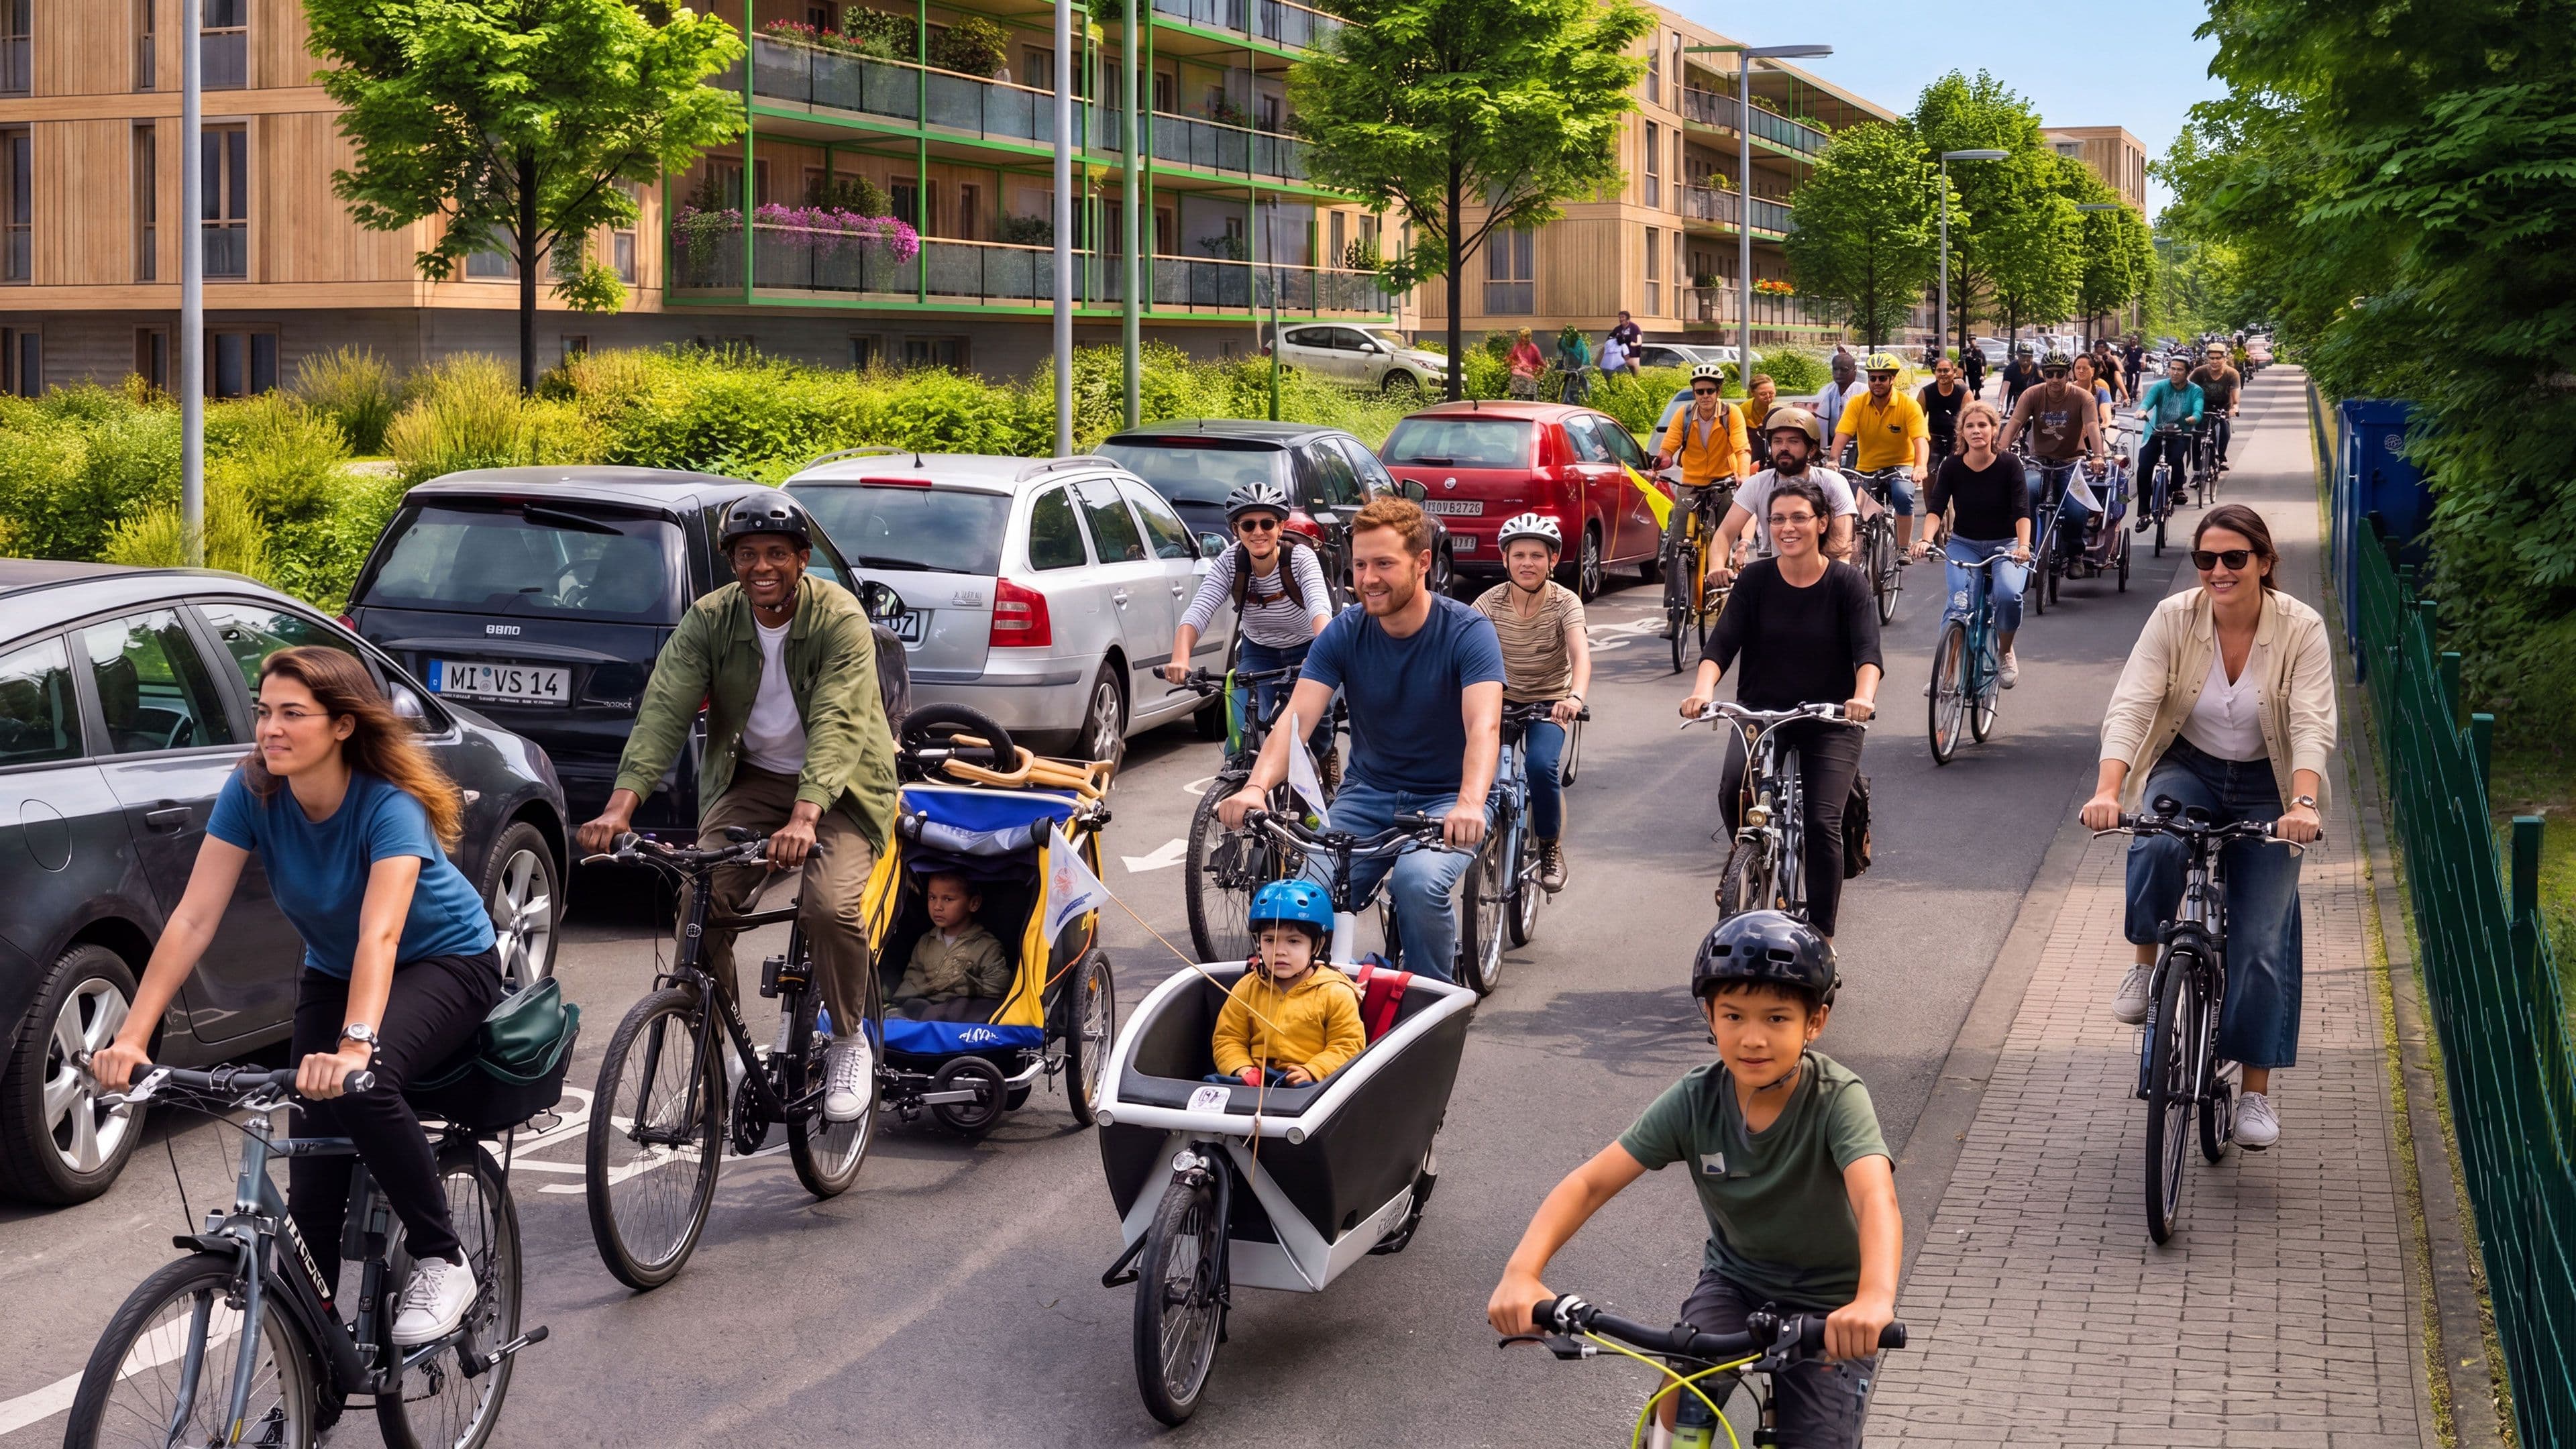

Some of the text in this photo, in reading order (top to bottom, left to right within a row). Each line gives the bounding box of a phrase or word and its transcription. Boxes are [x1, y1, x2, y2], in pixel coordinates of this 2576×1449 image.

[450, 665, 557, 696] MI VS 14
